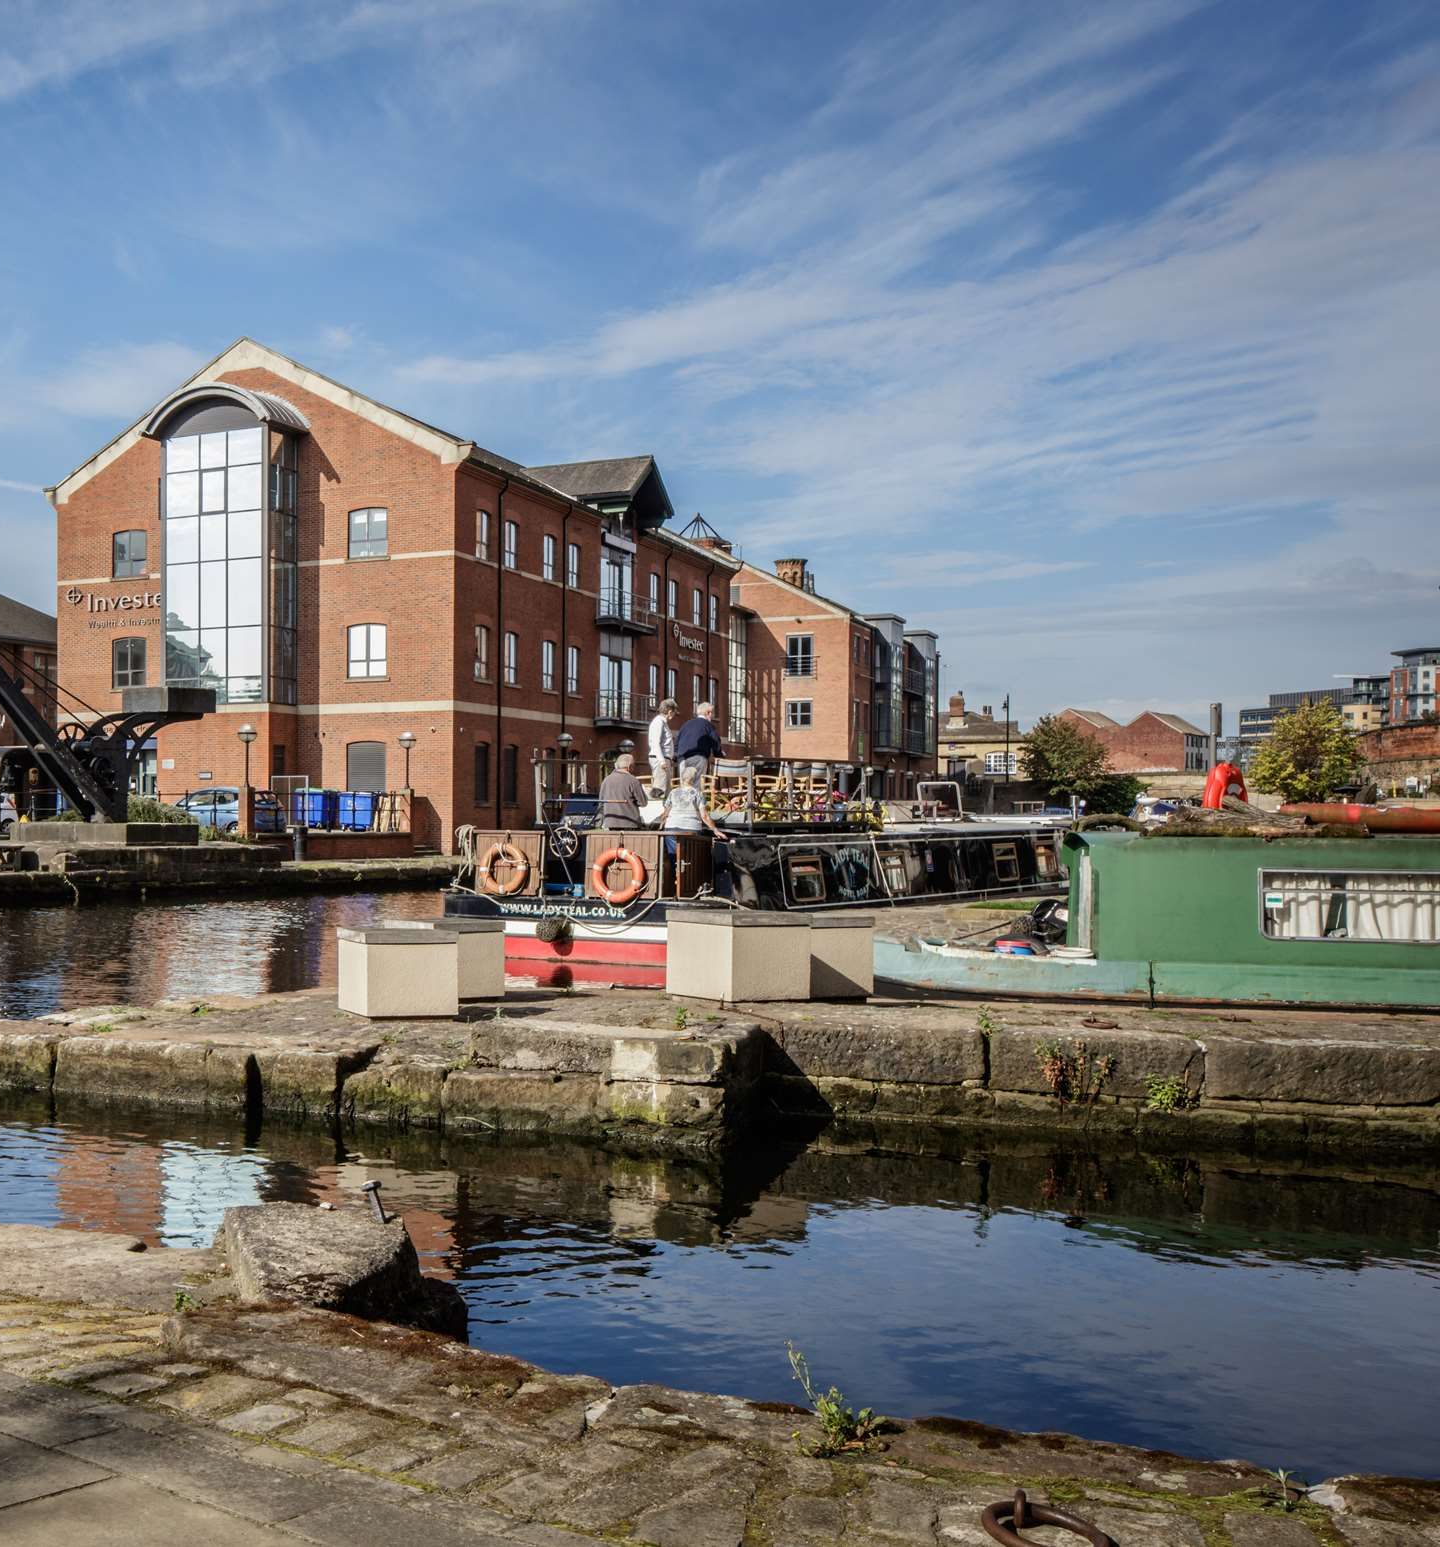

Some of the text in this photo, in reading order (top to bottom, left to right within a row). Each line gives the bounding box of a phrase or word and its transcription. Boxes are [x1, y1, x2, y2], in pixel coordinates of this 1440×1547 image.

[679, 631, 704, 652] Investec
[830, 847, 870, 872] LADY TEAL
[500, 903, 627, 918] WWW.LADYTEAL.CO.UK
